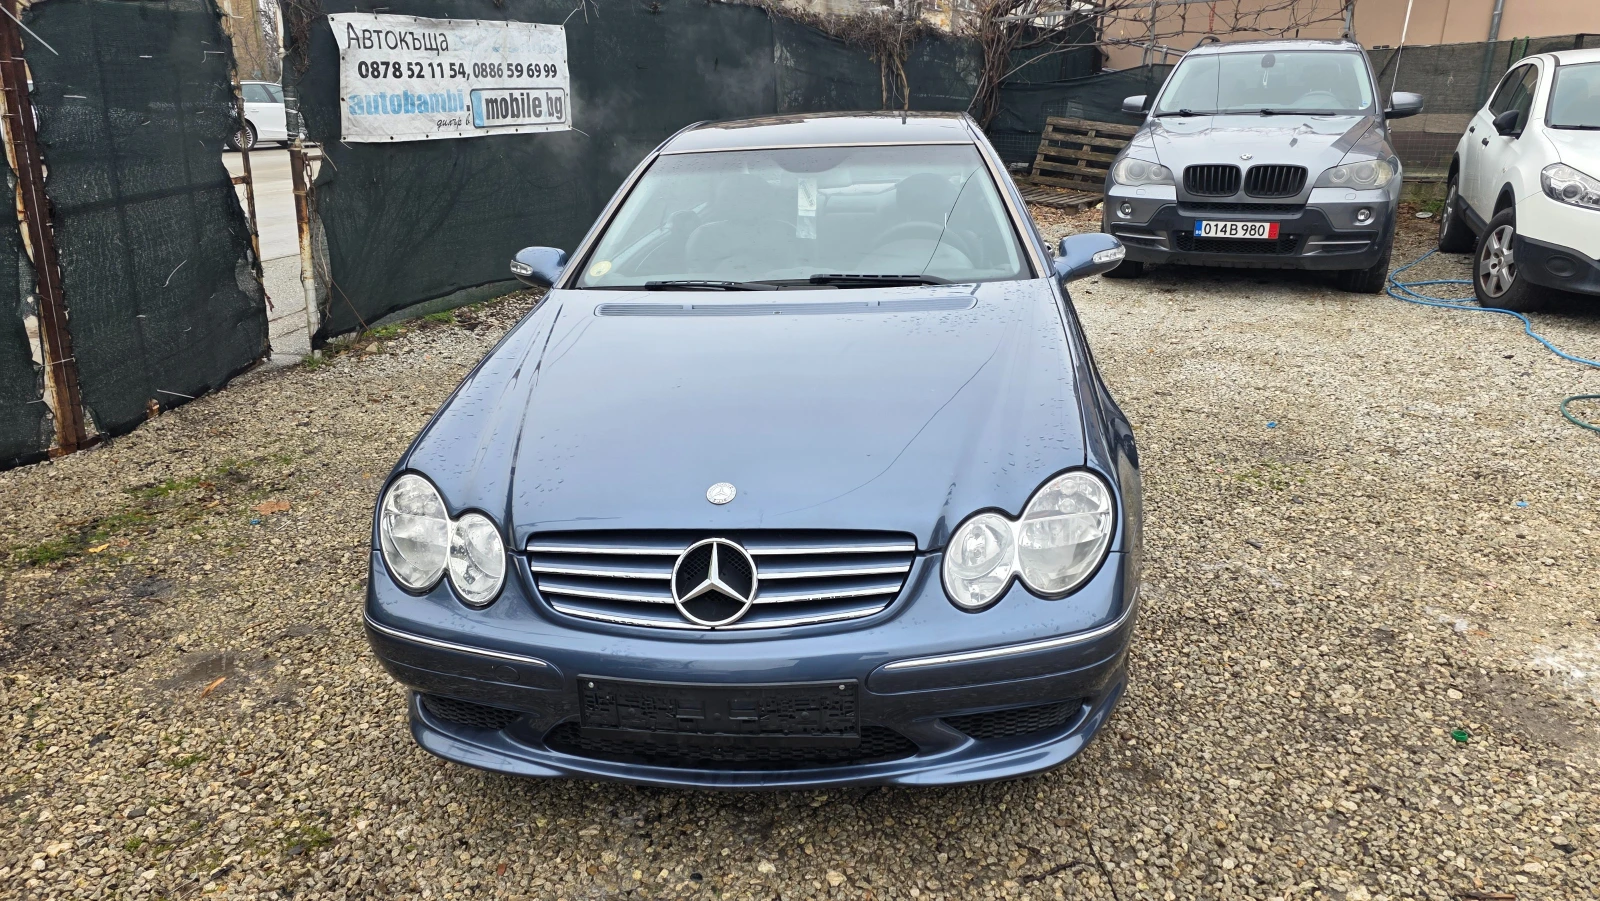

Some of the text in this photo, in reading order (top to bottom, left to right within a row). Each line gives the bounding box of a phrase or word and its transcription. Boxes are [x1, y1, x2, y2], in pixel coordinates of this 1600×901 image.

[346, 22, 449, 56] Автокъща
[357, 61, 403, 79] 0878
[407, 61, 425, 79] 52
[428, 62, 444, 78] 11
[507, 63, 524, 79] 59
[526, 63, 541, 79] 69
[543, 63, 557, 79] 99
[484, 91, 563, 120] mobile.bg
